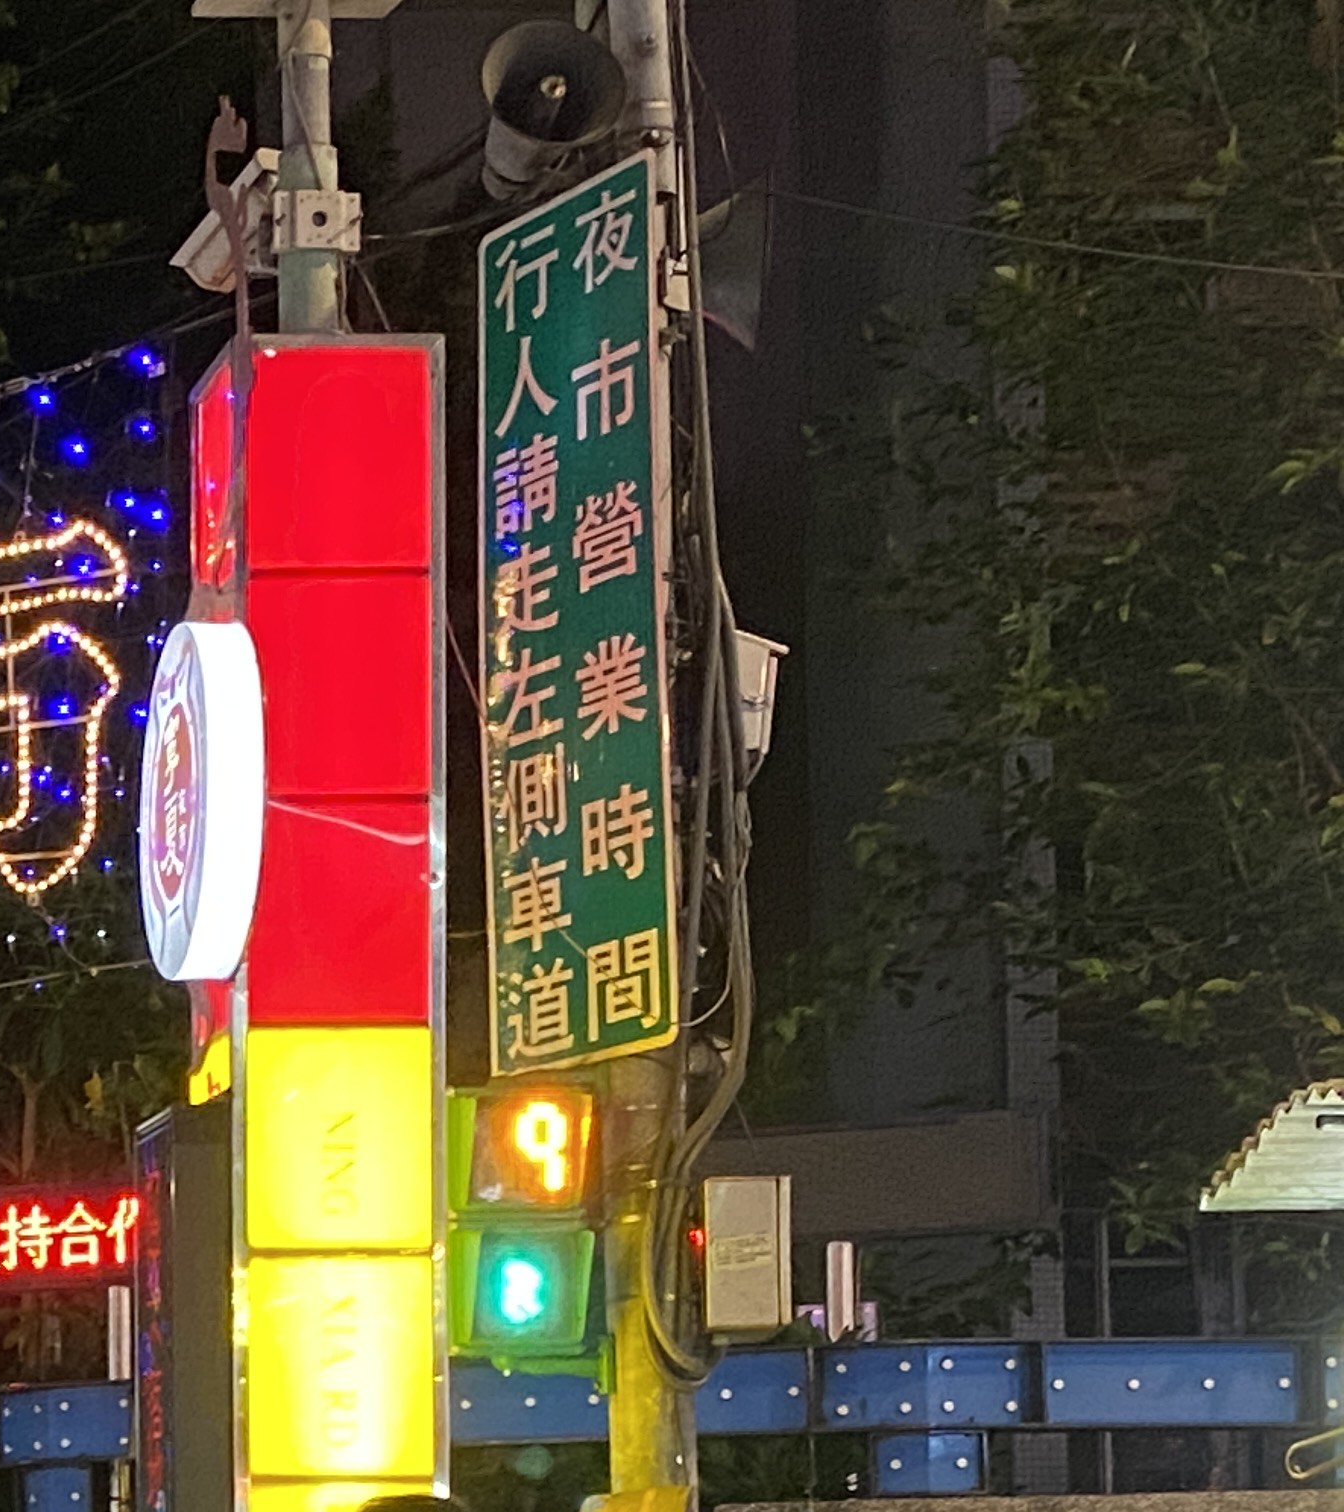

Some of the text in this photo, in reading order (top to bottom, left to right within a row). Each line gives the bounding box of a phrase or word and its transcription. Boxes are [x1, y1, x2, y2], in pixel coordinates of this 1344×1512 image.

[493, 223, 575, 1060] 行人請走左側車道
[572, 188, 662, 1046] 夜市營業時間
[515, 1101, 568, 1192] 9
